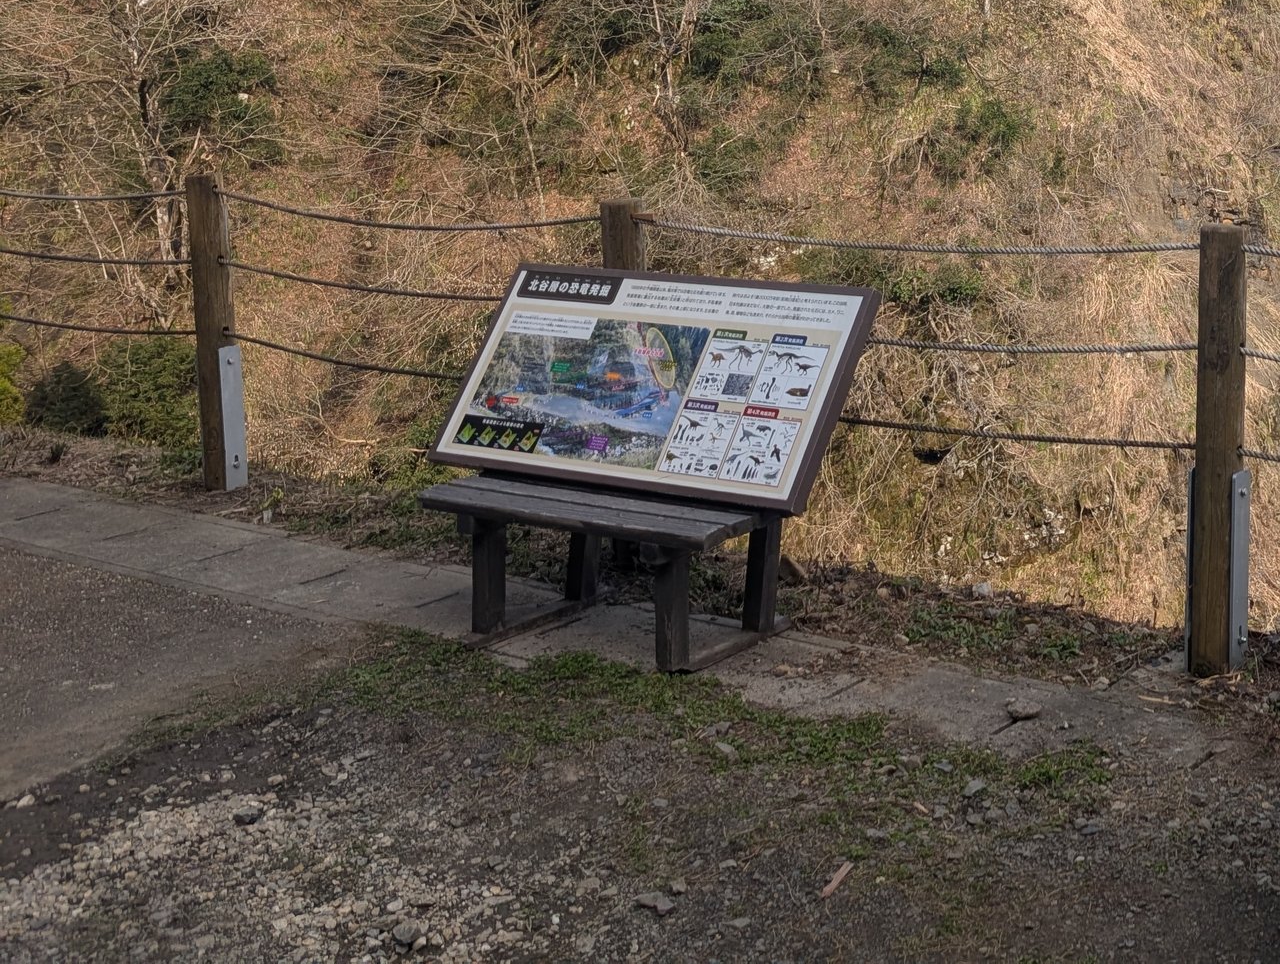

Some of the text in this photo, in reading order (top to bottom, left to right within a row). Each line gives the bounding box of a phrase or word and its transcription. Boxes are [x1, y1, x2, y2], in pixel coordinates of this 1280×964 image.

[528, 279, 611, 297] 北谷層の恐竜発掘
